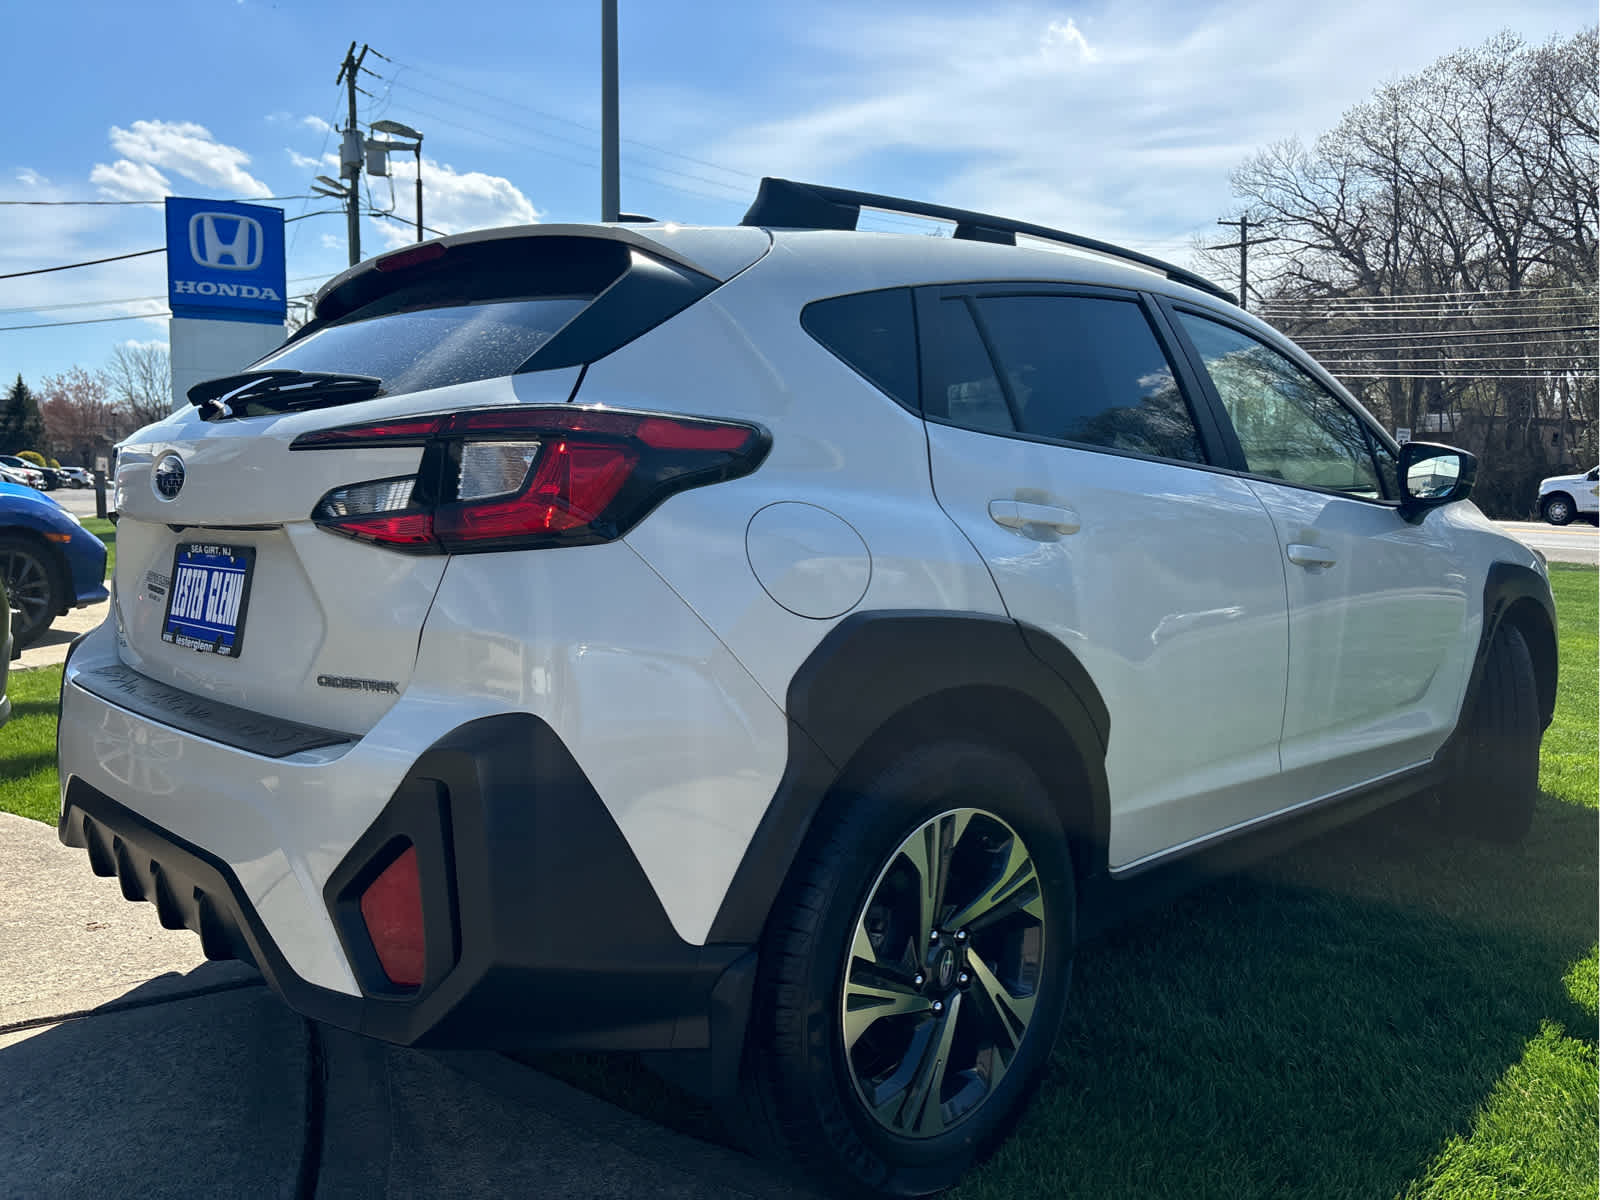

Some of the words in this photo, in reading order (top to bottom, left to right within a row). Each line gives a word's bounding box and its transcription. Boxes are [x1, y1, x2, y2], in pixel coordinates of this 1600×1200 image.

[174, 280, 281, 301] HONDA
[191, 544, 203, 553] SEA
[203, 546, 221, 556] GIRT,
[222, 547, 232, 556] NJ
[171, 567, 207, 620] LESTER
[205, 571, 245, 626] GLENN
[176, 635, 213, 651] lesterglenn
